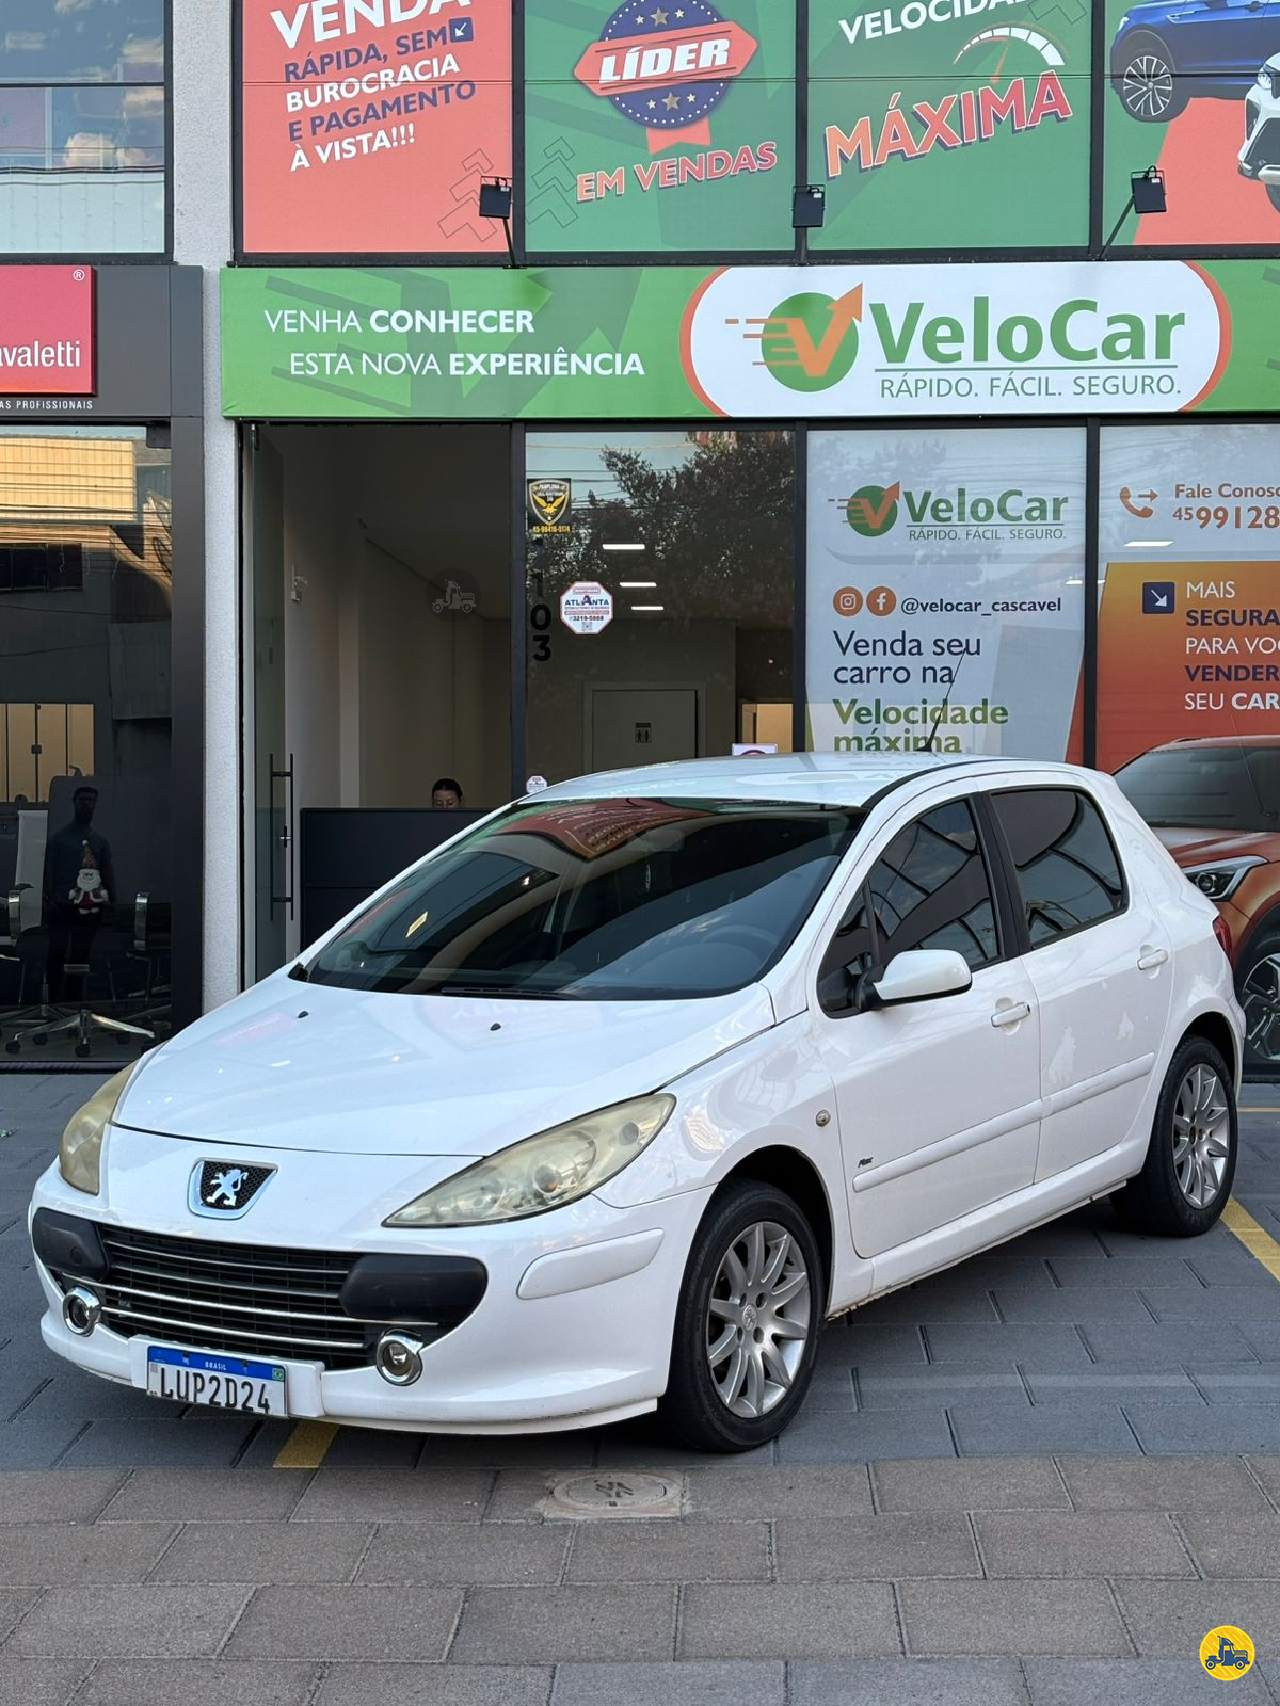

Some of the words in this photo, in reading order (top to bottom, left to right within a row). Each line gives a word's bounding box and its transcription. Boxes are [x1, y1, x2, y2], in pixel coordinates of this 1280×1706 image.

[284, 43, 389, 83] RÁPIDA,
[395, 25, 448, 56] SEM
[599, 38, 730, 84] LÍDER
[286, 53, 460, 113] BUROCRACIA
[288, 119, 303, 141] E
[310, 80, 476, 136] PAGAMENTO
[824, 69, 1073, 179] MÁXIMA
[290, 143, 310, 172] À
[315, 123, 416, 164] VISTA!!!
[577, 166, 625, 203] EM
[634, 141, 777, 191] VENDAS
[264, 309, 363, 333] VENHA
[369, 309, 535, 334] CONHECER
[868, 295, 1186, 364] VeloCar
[0, 340, 80, 368] valetti
[290, 352, 354, 376] ESTA
[361, 352, 442, 376] NOVA
[448, 346, 645, 376] EXPERIÊNCIA
[880, 370, 979, 398] RÁPIDO.
[989, 369, 1063, 398] FÁCIL.
[1072, 374, 1182, 397] SEGURO.
[16, 400, 93, 410] PROFISSIONAIS
[1174, 483, 1212, 498] Fale
[902, 487, 1069, 523] VeloCar
[909, 527, 961, 541] RÁPIDO.
[1009, 528, 1067, 539] SEGURO.
[564, 594, 609, 606] ATLANTA
[1186, 581, 1236, 599] MAIS
[900, 597, 1061, 616] @velocar_cascavel
[1186, 609, 1280, 627] SEGURA
[832, 630, 924, 657] Venda
[932, 637, 981, 657] seu
[1185, 638, 1239, 655] PARA
[1244, 637, 1280, 655] VO
[833, 665, 911, 684] carro
[922, 665, 956, 684] na
[1184, 665, 1280, 682] VENDER
[832, 698, 1009, 725] Velocidade
[1184, 692, 1224, 710] SEU
[1231, 692, 1280, 710] CAR
[833, 727, 963, 753] máxima
[160, 1366, 270, 1414] LUP2D24
